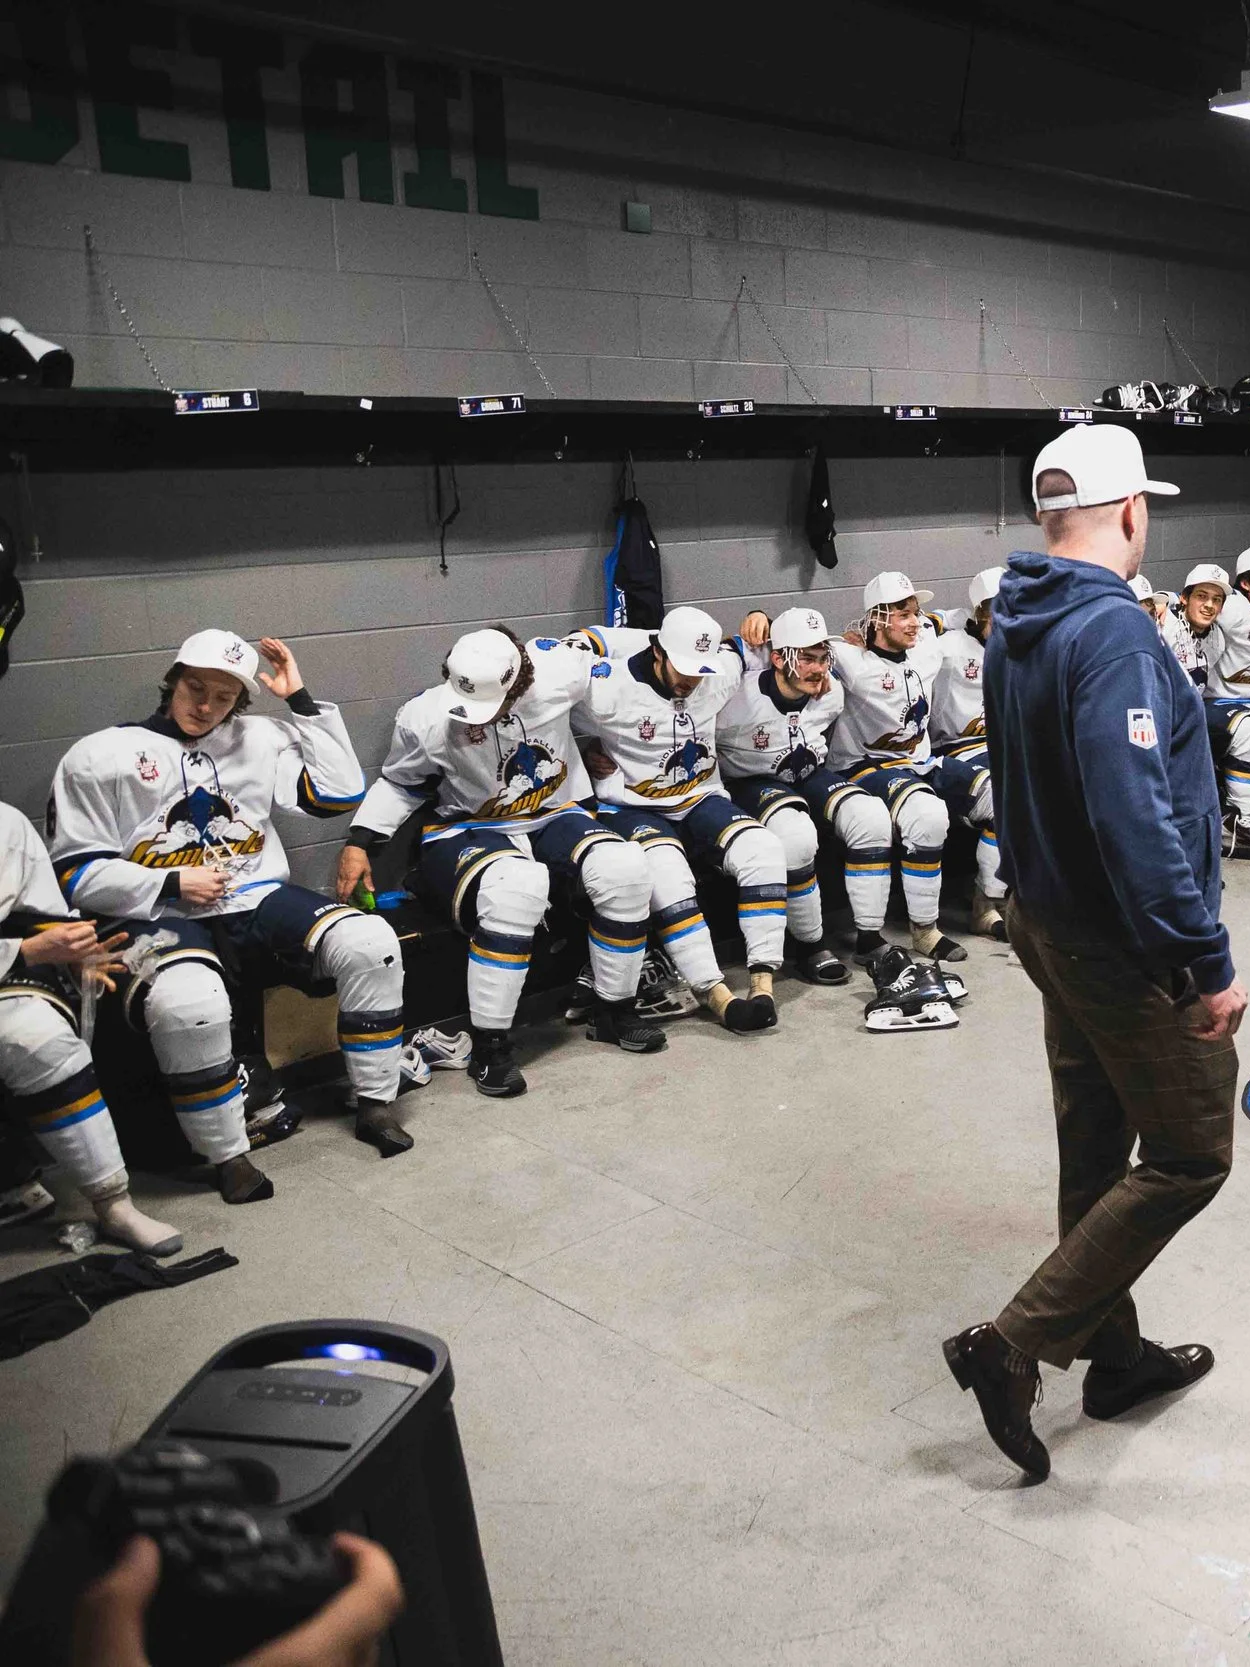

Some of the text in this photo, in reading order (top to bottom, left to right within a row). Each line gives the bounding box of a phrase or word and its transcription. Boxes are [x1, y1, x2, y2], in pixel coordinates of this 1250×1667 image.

[202, 396, 230, 409] STUART
[511, 396, 522, 408] 71
[743, 401, 754, 411] 28
[526, 737, 556, 756] FALLS
